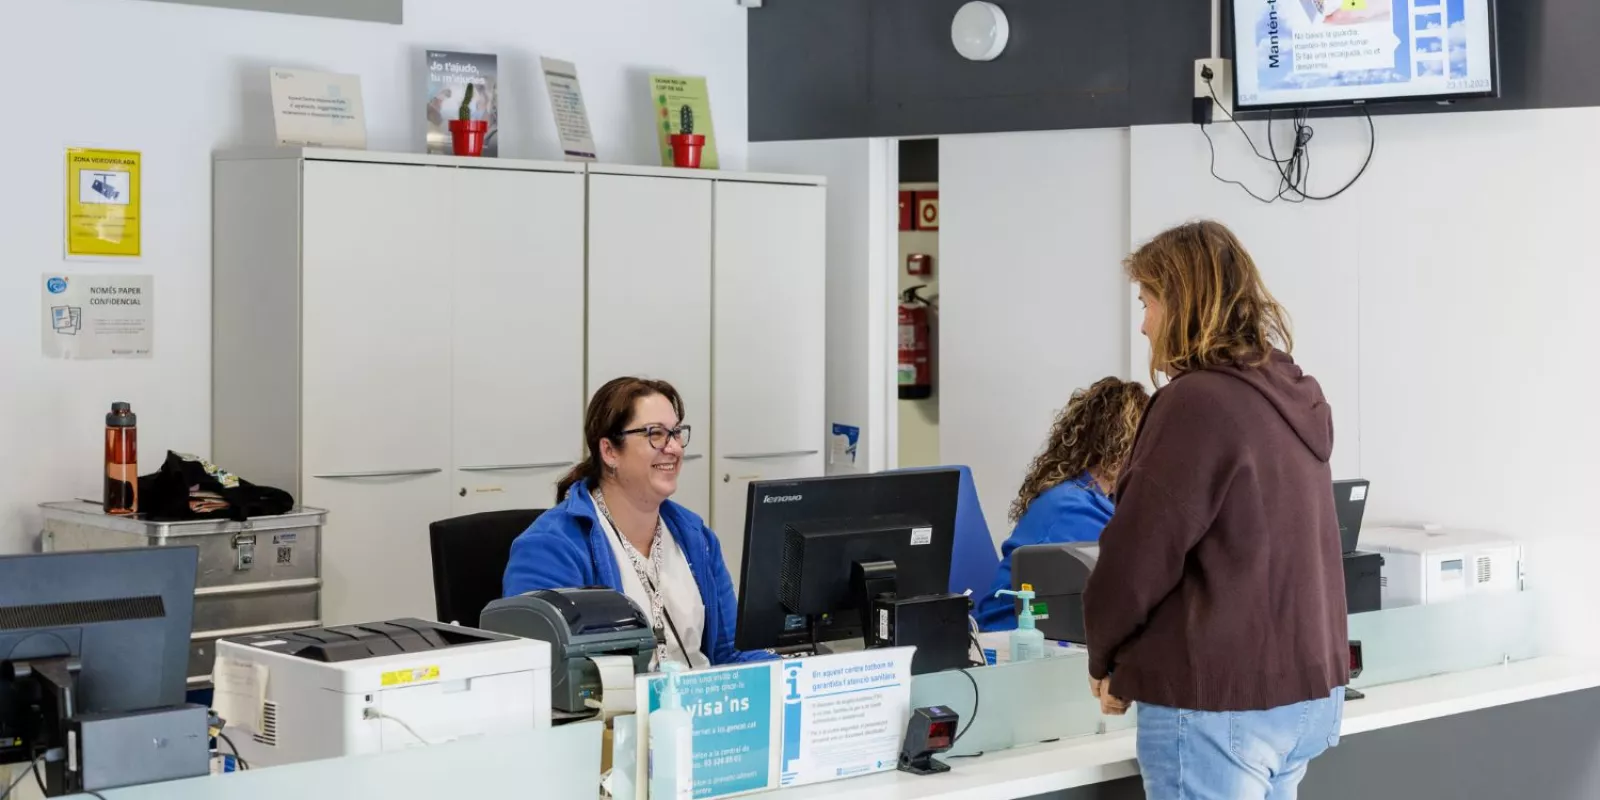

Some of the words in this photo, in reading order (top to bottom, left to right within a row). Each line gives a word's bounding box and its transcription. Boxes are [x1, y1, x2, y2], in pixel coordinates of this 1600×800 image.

[430, 61, 442, 71] Jo
[445, 62, 479, 74] t'ajudo,
[430, 72, 440, 81] tu
[90, 286, 117, 294] NOMÉS
[763, 495, 802, 503] lenovo
[812, 670, 821, 678] En
[823, 667, 843, 678] aquest
[845, 665, 863, 674] centre
[686, 696, 749, 717] visa'ns
